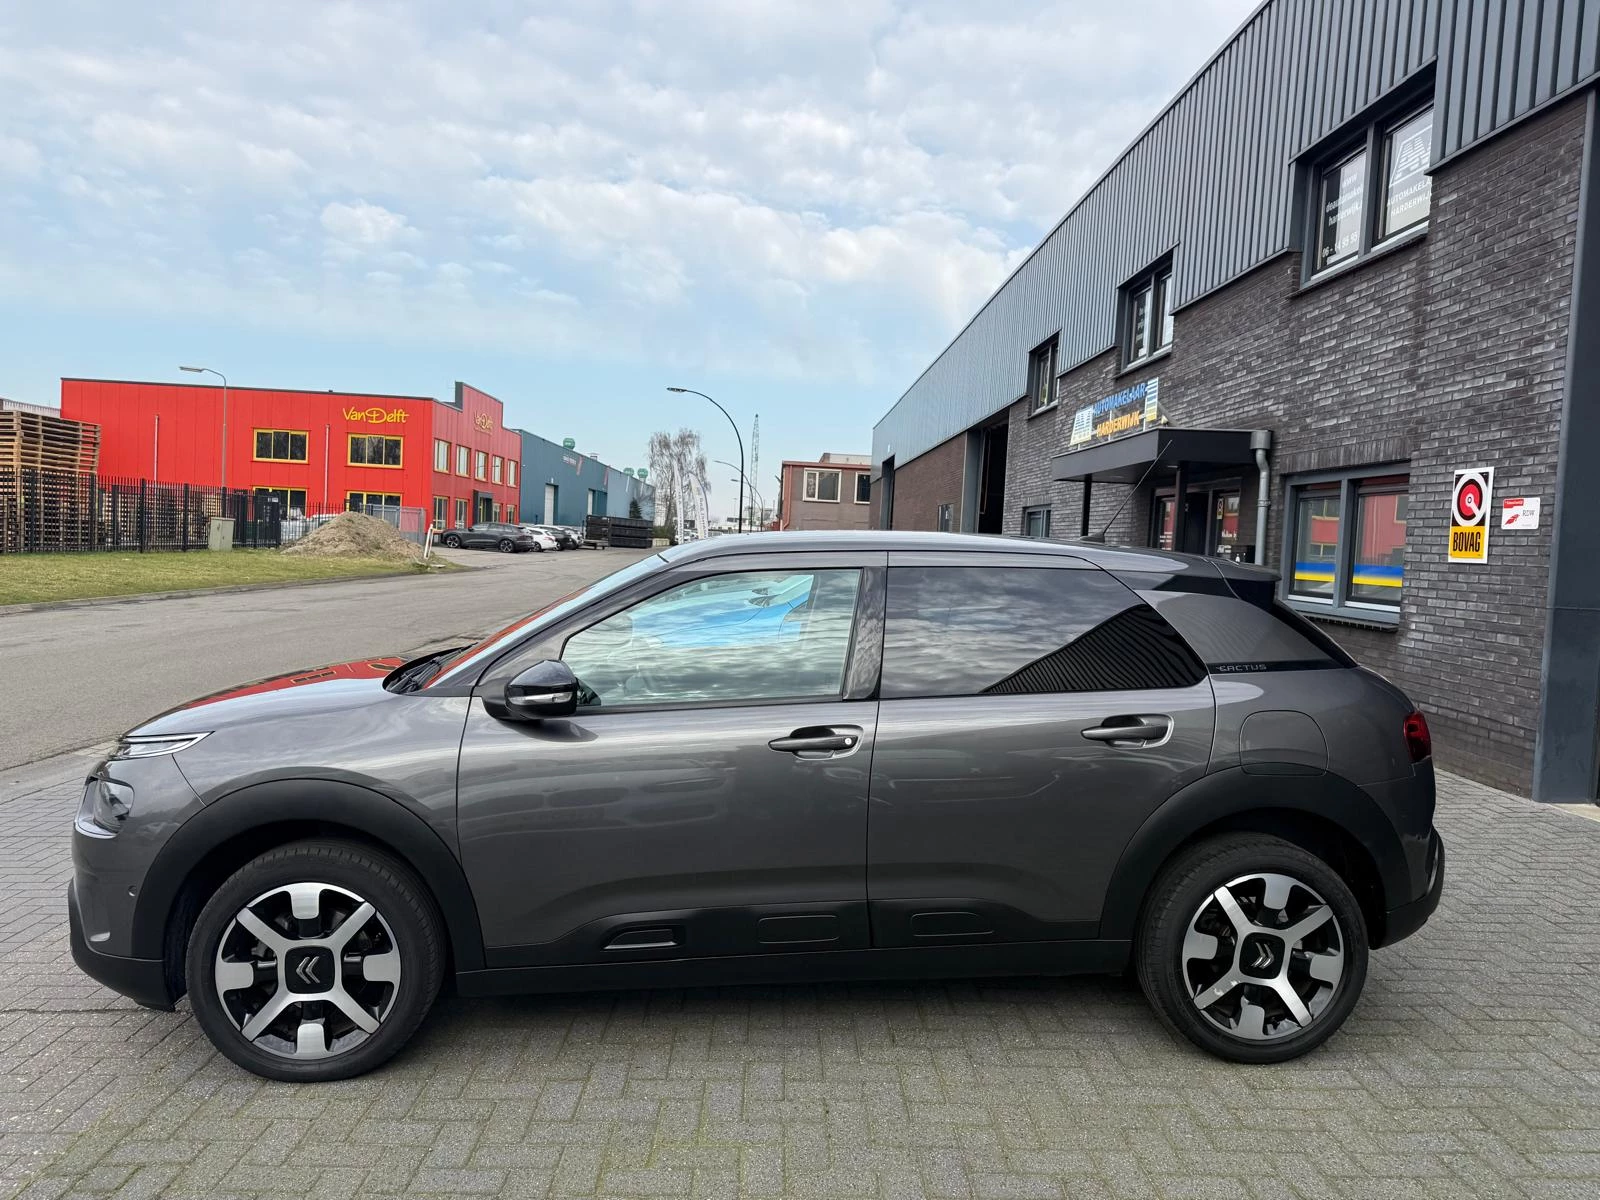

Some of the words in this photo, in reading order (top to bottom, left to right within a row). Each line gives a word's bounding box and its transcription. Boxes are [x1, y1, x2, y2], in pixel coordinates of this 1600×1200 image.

[1093, 382, 1147, 416] AUTOMAKELAAR
[1096, 410, 1140, 437] HARDERWIJK
[1452, 531, 1481, 552] BOVAG
[1216, 664, 1267, 672] CACTUS
